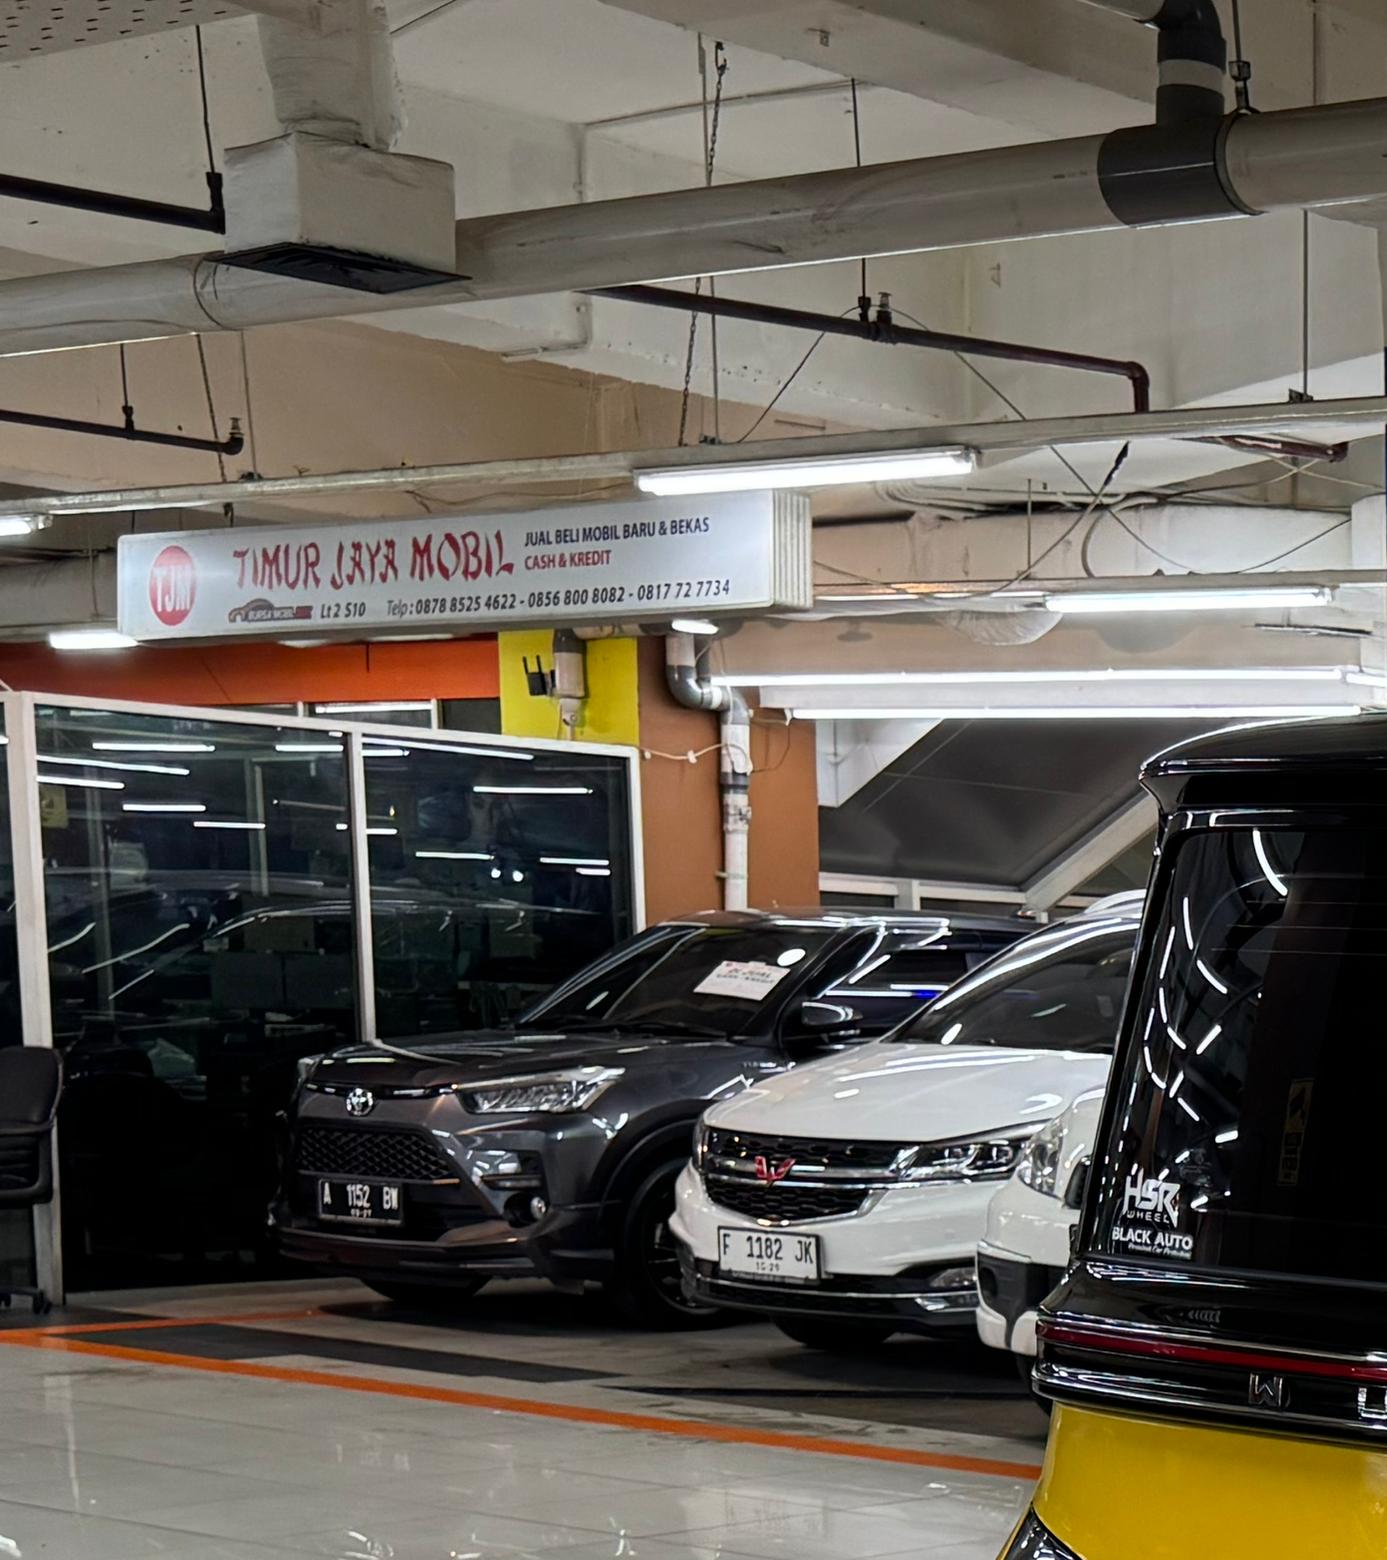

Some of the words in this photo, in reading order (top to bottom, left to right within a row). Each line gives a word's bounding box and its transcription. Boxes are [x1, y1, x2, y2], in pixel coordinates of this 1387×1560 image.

[524, 531, 552, 547] JUAL
[555, 528, 579, 544] BELI
[582, 525, 620, 542] MOBIL
[623, 522, 655, 539] BARU
[658, 521, 667, 535] &
[670, 517, 710, 534] BEKAS
[233, 542, 320, 590] TIMUR
[330, 538, 398, 590] JAYA
[410, 530, 514, 582] MOBIL
[524, 553, 555, 570] CASH
[558, 552, 567, 567] &
[569, 550, 611, 567] KREDIT
[154, 565, 194, 612] TJM
[415, 598, 447, 615] 0878
[450, 595, 481, 612] 8525
[484, 593, 516, 611] 4622
[528, 590, 560, 608] 0856
[564, 588, 588, 605] 800
[591, 586, 625, 604] 8082
[637, 583, 671, 600] 0817
[675, 581, 692, 599] 72
[696, 579, 730, 597] 7734
[323, 1182, 332, 1205] A
[346, 1184, 371, 1208] 1152
[1122, 1168, 1181, 1228] HSR
[1126, 1209, 1170, 1224] WHEEL
[723, 1233, 731, 1255] F
[746, 1235, 783, 1260] 1182
[795, 1240, 814, 1264] JK
[1112, 1226, 1151, 1245] BLACK
[1154, 1231, 1194, 1250] AUTO
